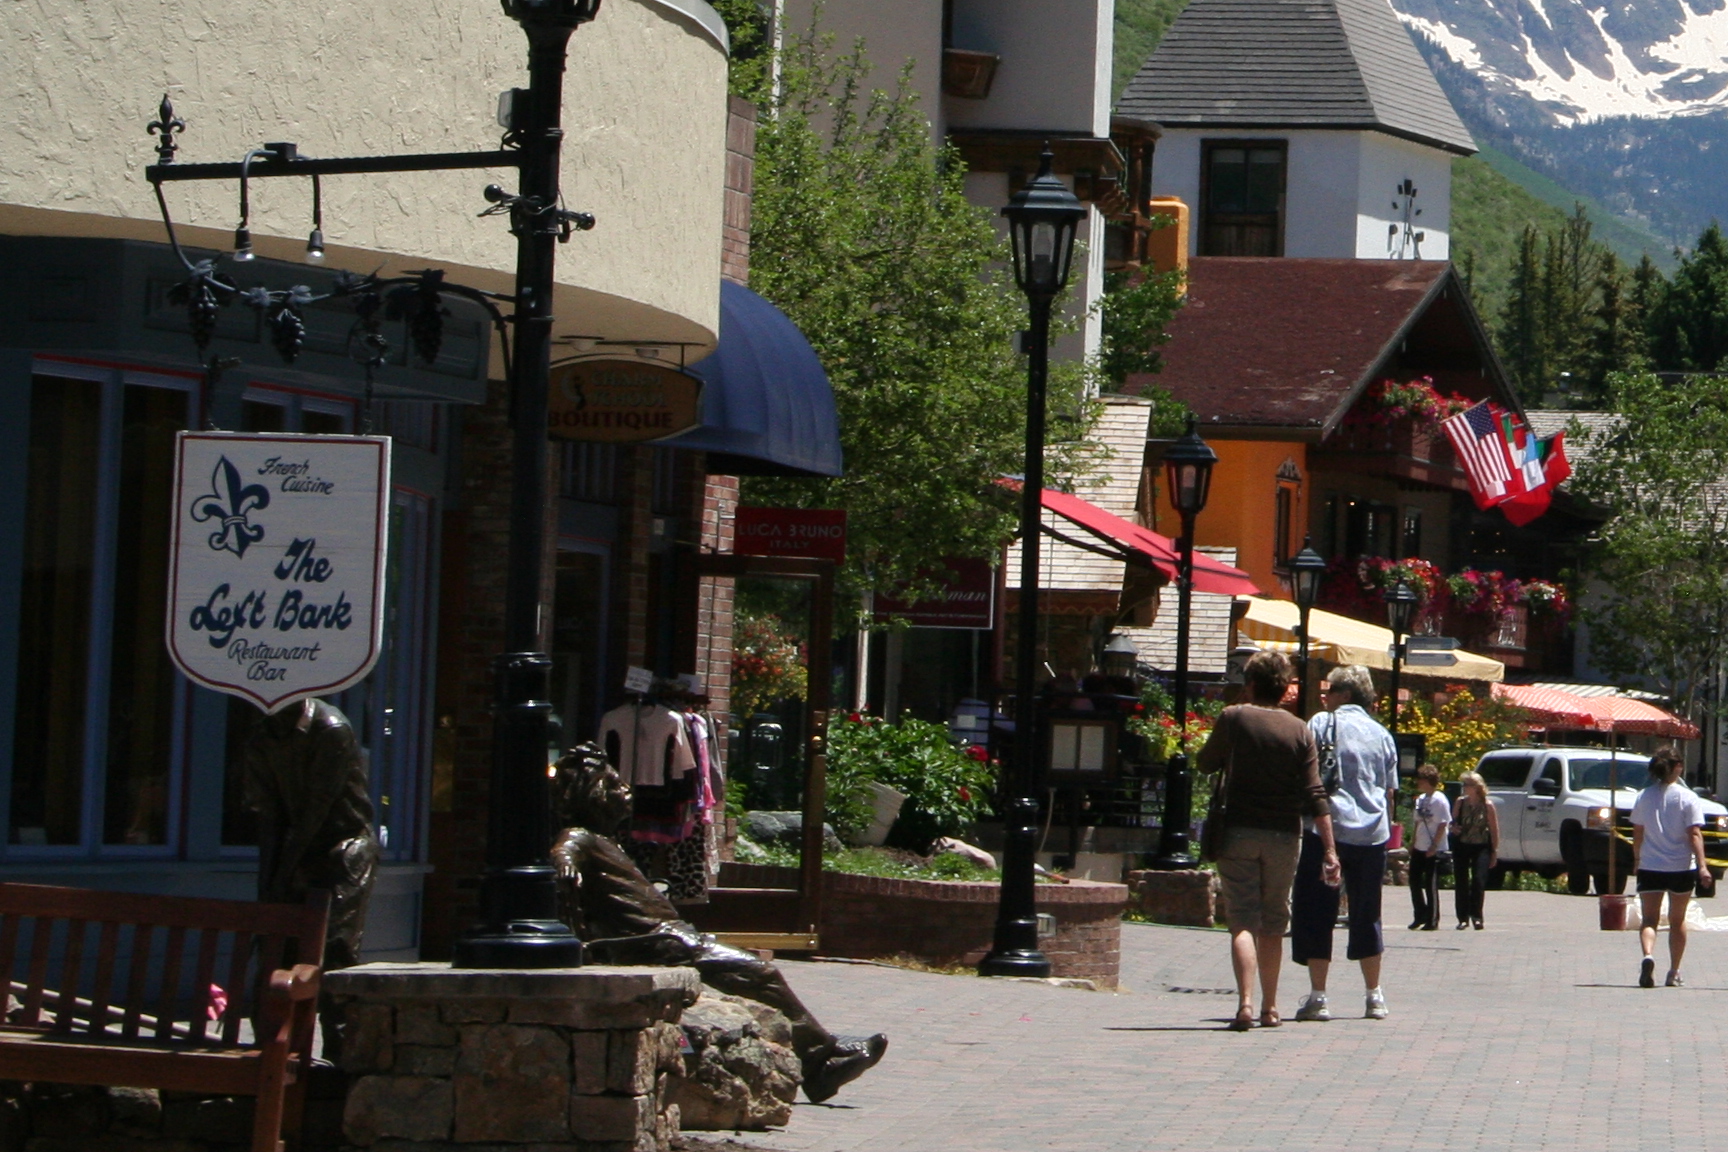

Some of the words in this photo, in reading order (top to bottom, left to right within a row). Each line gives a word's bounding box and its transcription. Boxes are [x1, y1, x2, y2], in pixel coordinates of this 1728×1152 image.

[548, 411, 674, 430] BOUTIQUE
[258, 456, 310, 477] French
[281, 476, 335, 496] Cuisine
[738, 522, 782, 537] LUCA
[789, 524, 843, 539] BRUNO
[770, 539, 810, 549] ITALY
[274, 537, 334, 583] The
[190, 583, 267, 648] Left
[273, 590, 352, 631] Bank
[228, 638, 321, 665] Restaurant
[247, 660, 287, 681] Bar
